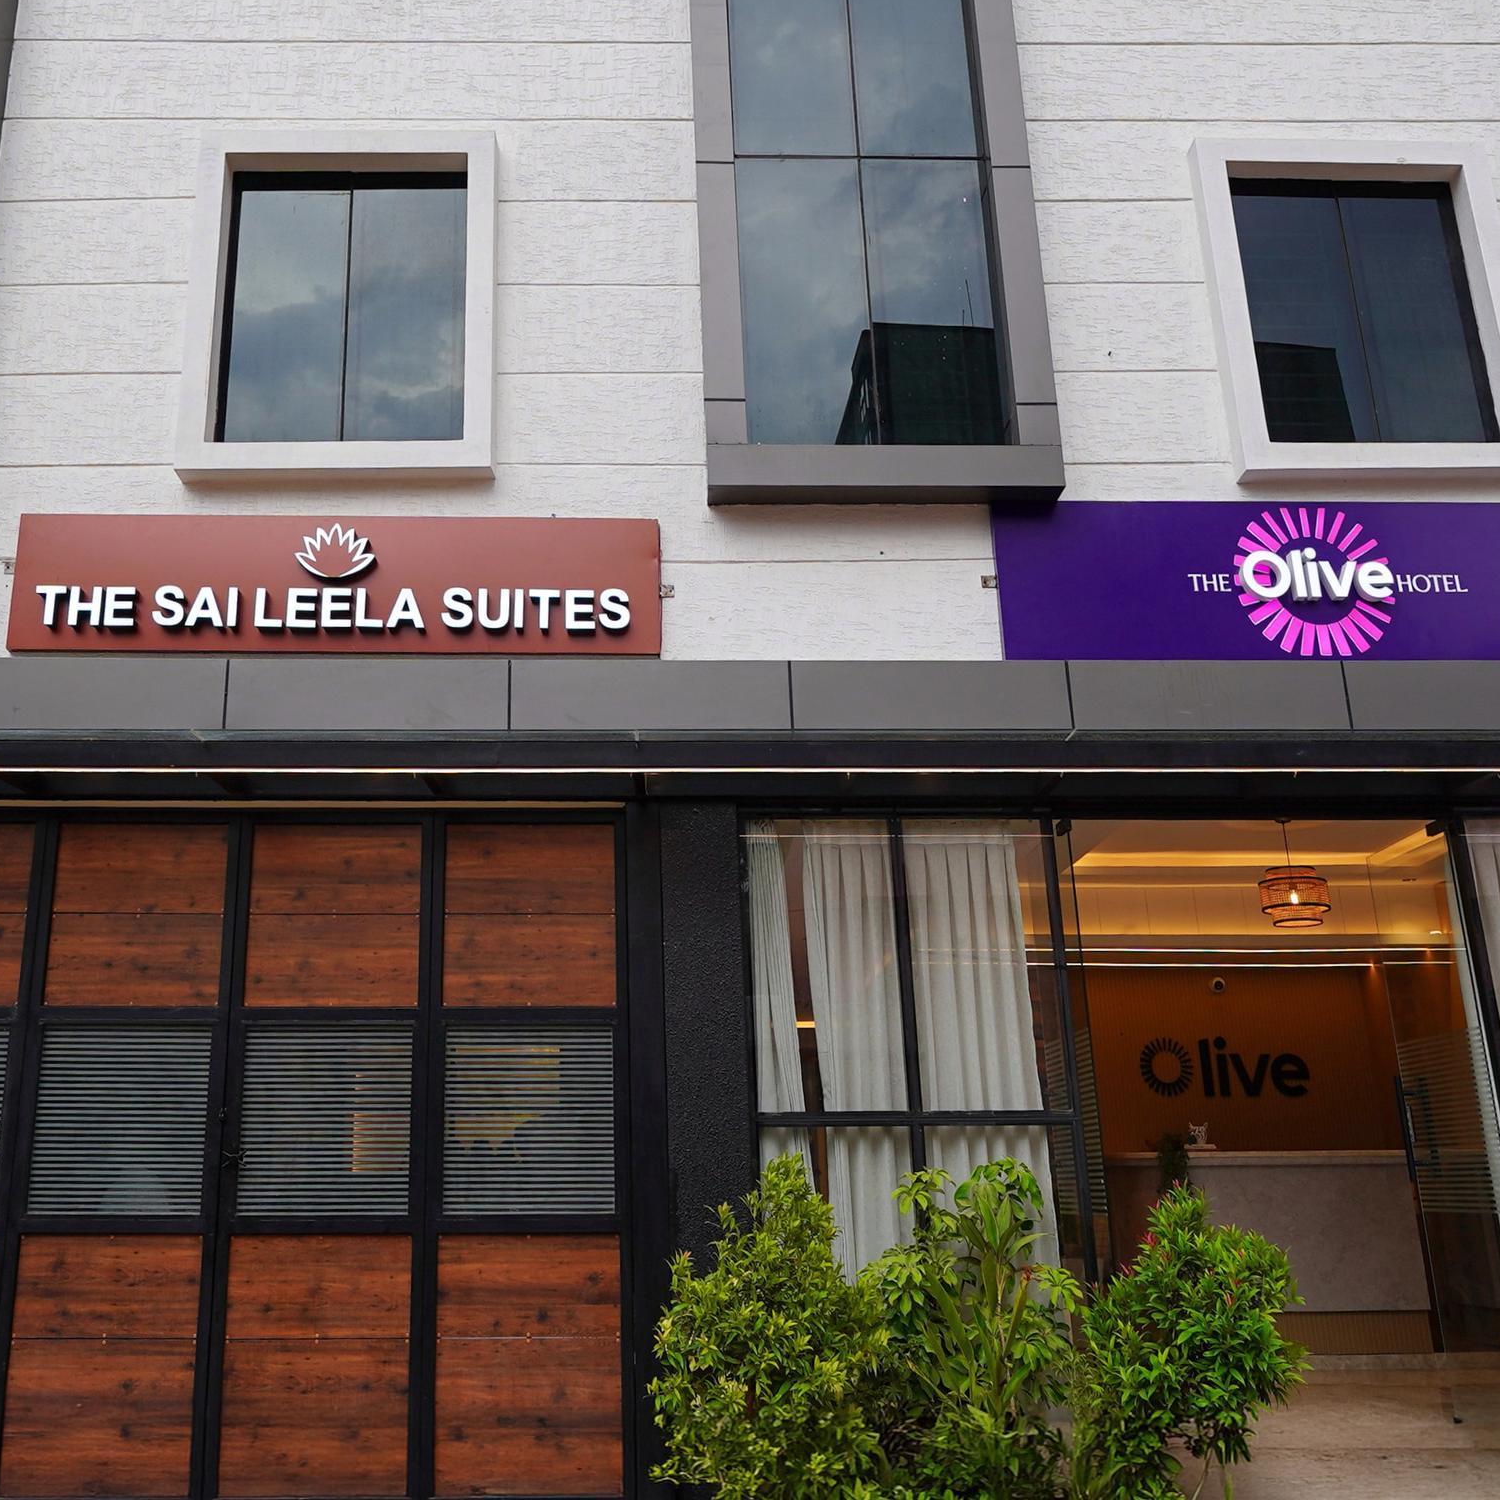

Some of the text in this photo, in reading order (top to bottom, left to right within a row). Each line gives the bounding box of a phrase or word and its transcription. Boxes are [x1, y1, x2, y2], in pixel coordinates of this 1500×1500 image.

[1187, 547, 1468, 601] THE Olive HOTEL
[35, 585, 632, 631] THE SAI LEELA SUITES
[1140, 1036, 1310, 1098] Olive
